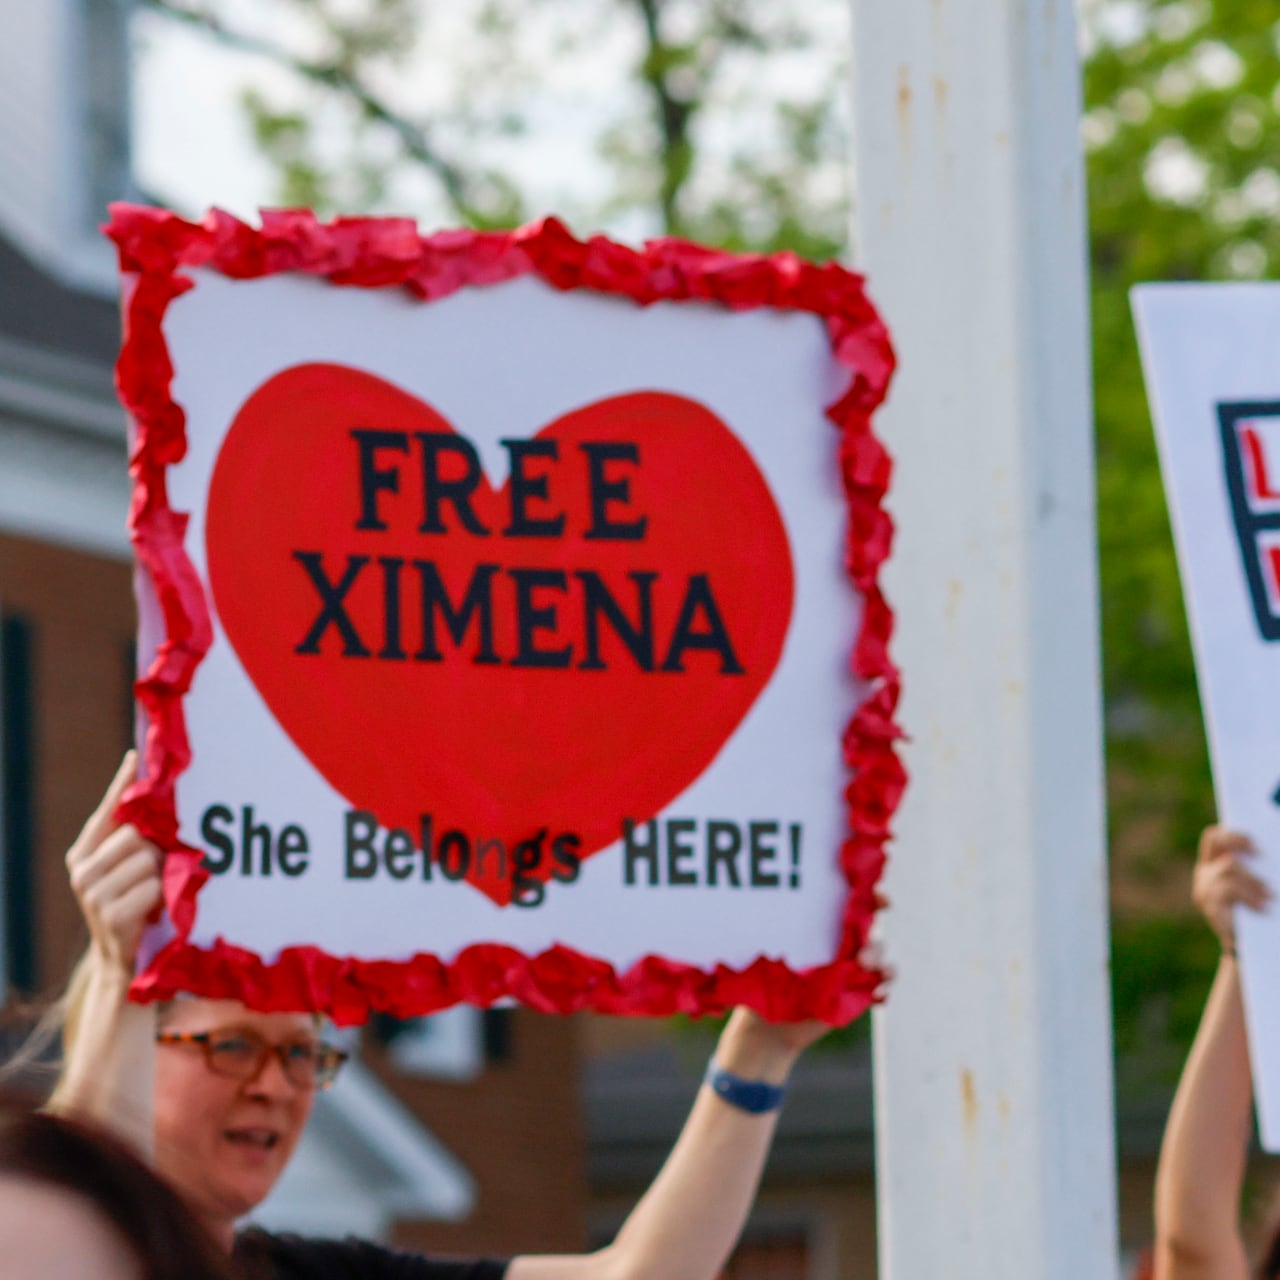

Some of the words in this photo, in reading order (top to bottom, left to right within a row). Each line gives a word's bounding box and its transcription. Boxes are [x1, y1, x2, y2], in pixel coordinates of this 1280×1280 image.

[349, 429, 649, 543] FREE
[291, 550, 747, 678] XIMENA
[200, 804, 310, 878] She
[344, 812, 582, 908] Belongs
[623, 817, 804, 890] HERE!
